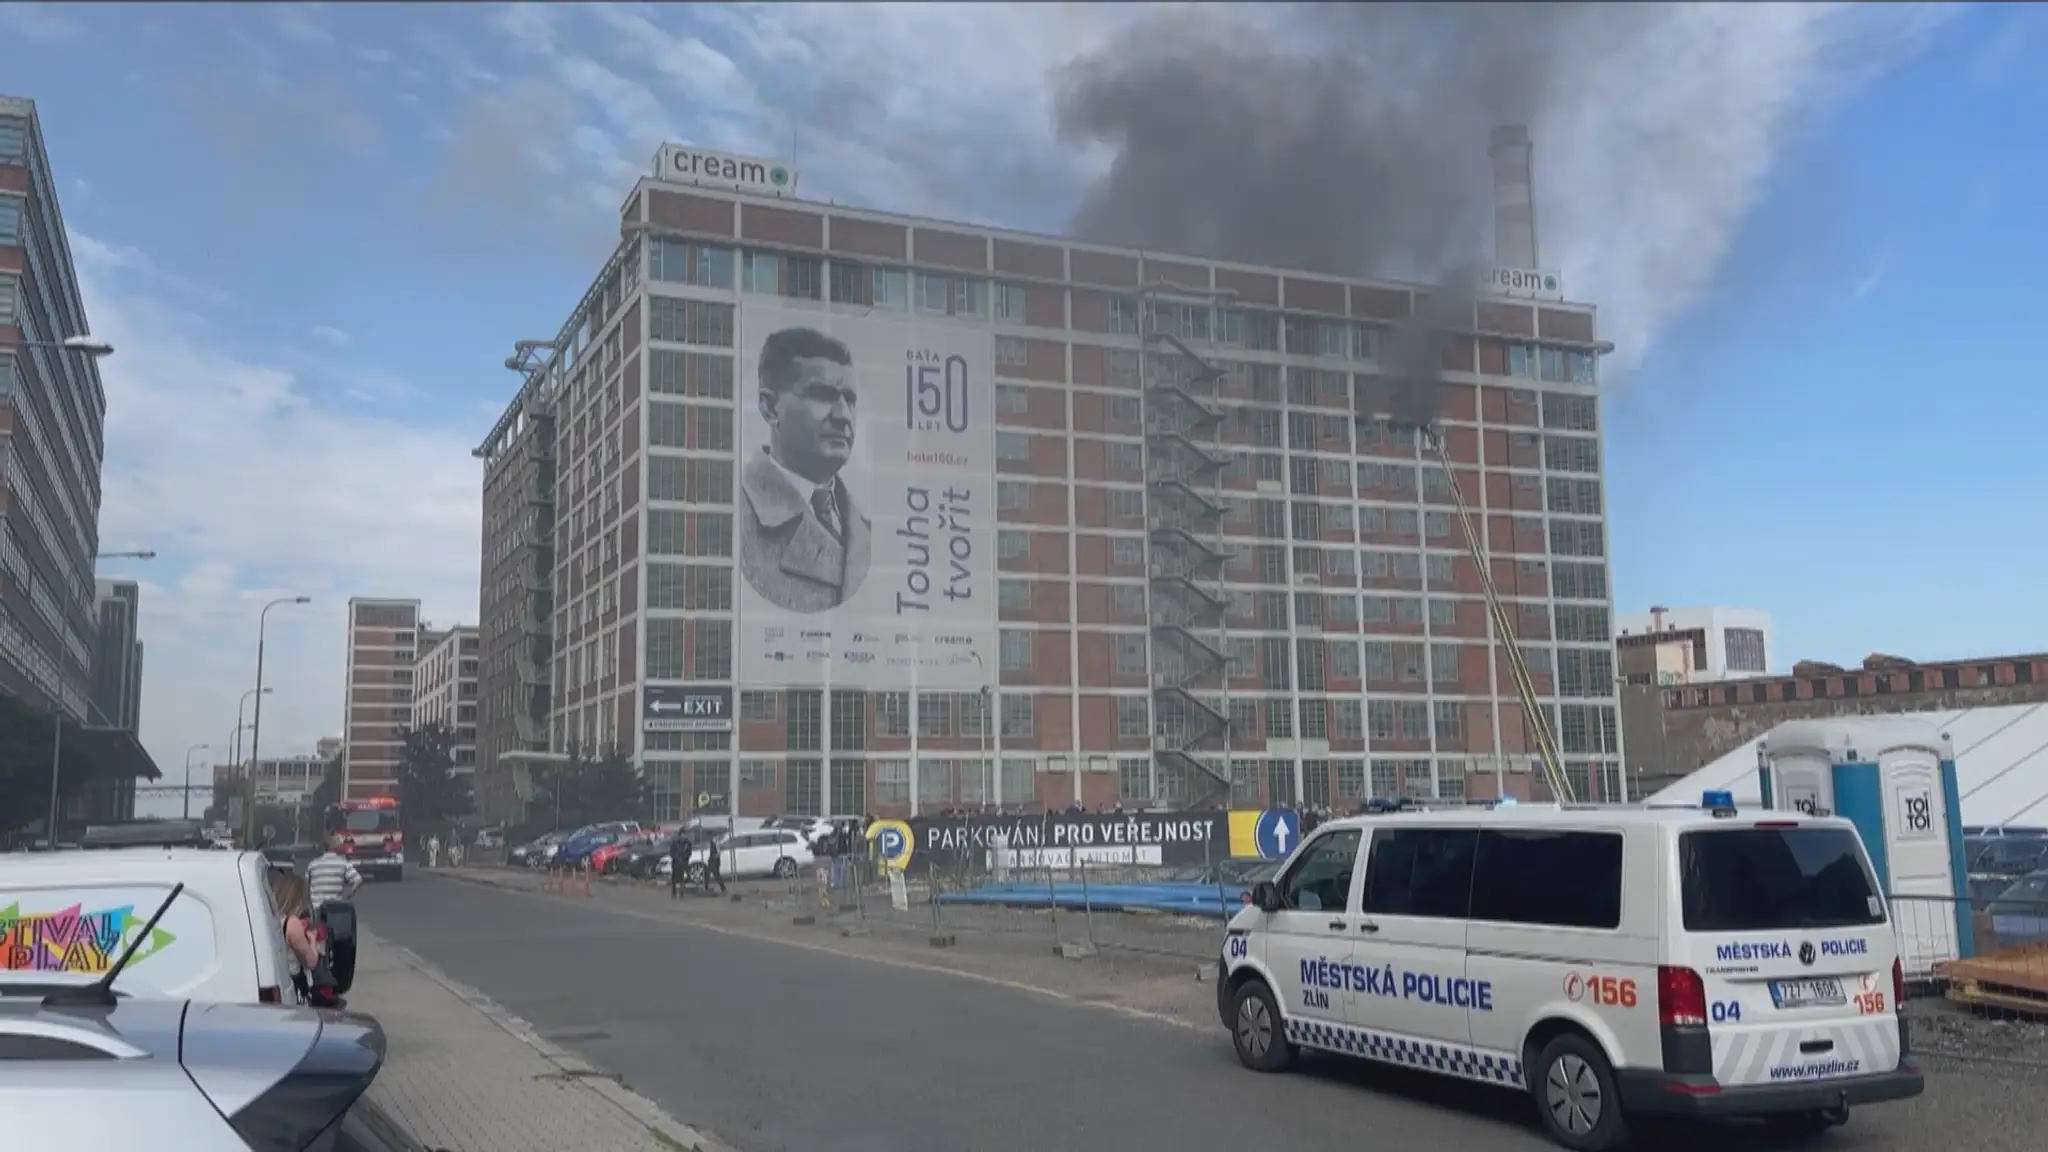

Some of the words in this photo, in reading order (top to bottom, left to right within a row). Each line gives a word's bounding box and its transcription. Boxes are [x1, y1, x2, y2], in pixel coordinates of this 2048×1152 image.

[906, 353, 968, 433] 150
[896, 486, 930, 615] Touha
[938, 486, 971, 602] tvořit
[683, 695, 722, 715] EXIT
[1054, 823, 1094, 845] PRO
[1100, 816, 1214, 843] VEŘEJNOST
[1907, 812, 1931, 830] TOI
[8, 937, 115, 971] PLAY
[1231, 938, 1247, 958] 04
[1716, 938, 1792, 961] MĚSTSKÁ
[1821, 938, 1868, 956] POLICIE
[1300, 956, 1398, 998] MĚSTSKÁ
[1402, 970, 1493, 1011] POLICIE
[1587, 975, 1637, 1009] 156
[1303, 987, 1329, 1010] ZLÍN
[1854, 992, 1885, 1014] 156
[1711, 1000, 1741, 1022] 04
[1770, 1058, 1860, 1079] www.mpzlin.cz
